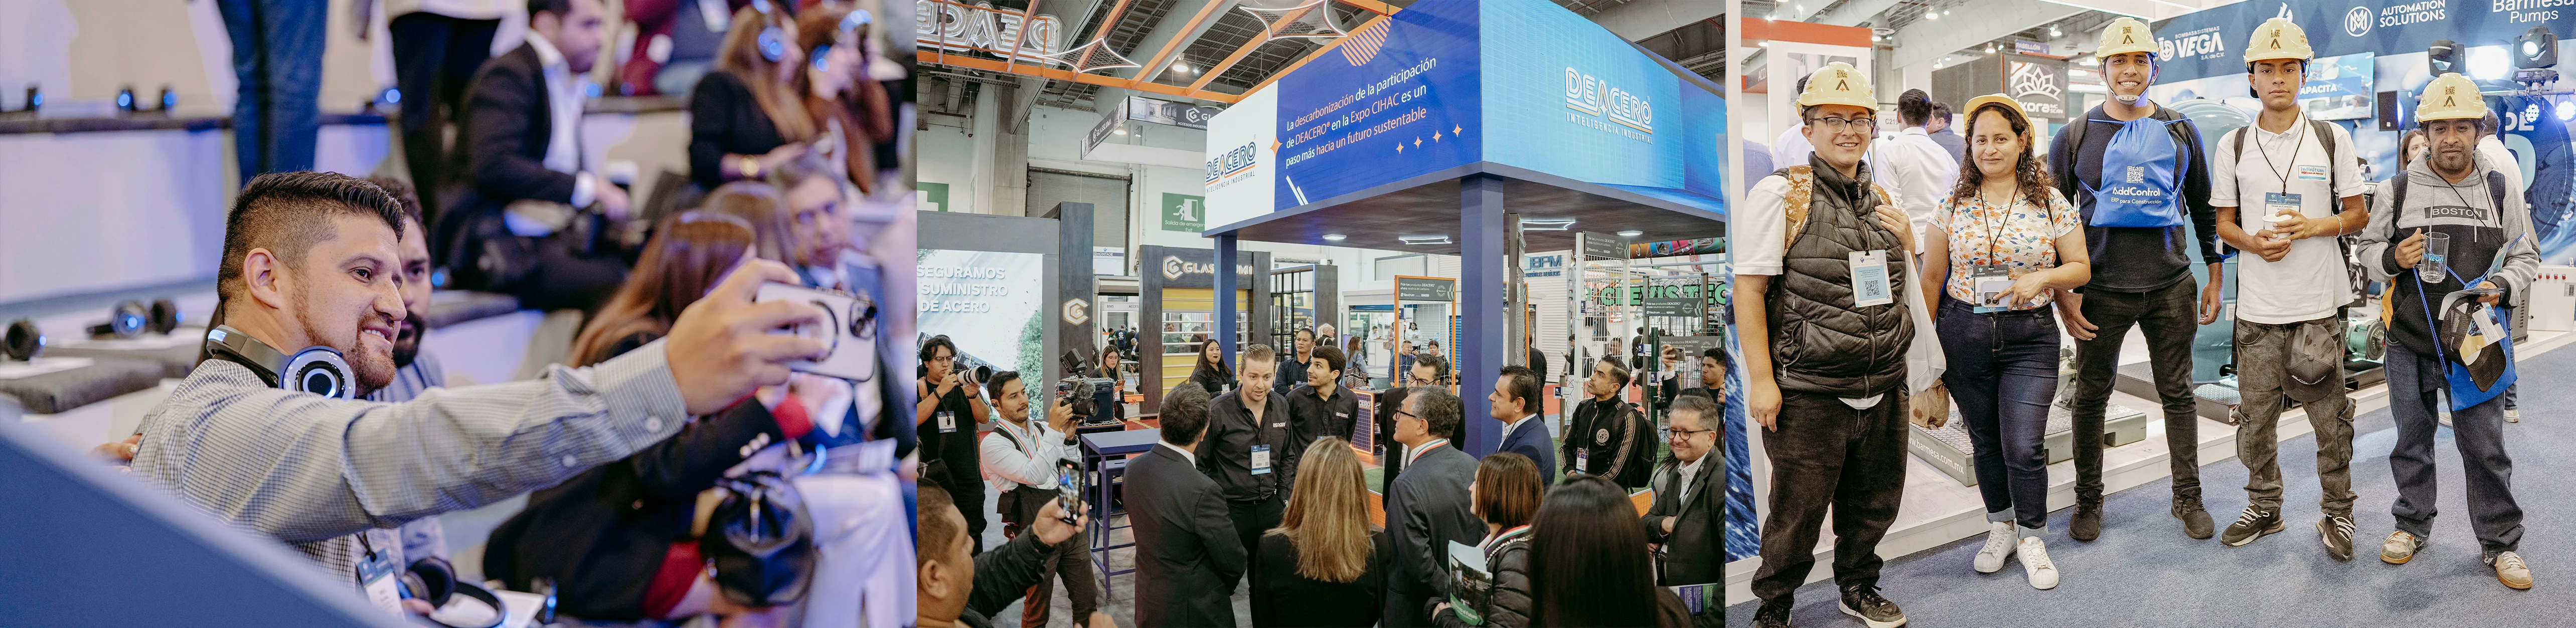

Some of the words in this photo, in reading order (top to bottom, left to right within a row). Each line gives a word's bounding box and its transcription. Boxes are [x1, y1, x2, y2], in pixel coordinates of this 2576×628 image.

[2381, 0, 2446, 17] AUTOMATION
[2379, 9, 2446, 28] SOLUTIONS
[2510, 10, 2558, 24] Pumps
[2175, 32, 2224, 58] VEGA
[1287, 121, 1294, 131] La
[1295, 94, 1354, 127] descarbonización
[1355, 88, 1366, 101] de
[1367, 84, 1375, 96] la
[1377, 57, 1436, 95] participación
[1286, 137, 1295, 149] de
[1331, 120, 1341, 131] en
[1342, 115, 1349, 126] la
[1351, 108, 1370, 123] Expo
[1372, 92, 1399, 115] CIHAC
[1401, 91, 1411, 103] es
[1414, 85, 1426, 98] un
[1566, 112, 1619, 135] INTELIGENCIA
[1621, 128, 1653, 144] INDUSTRIAL
[1286, 154, 1301, 169] paso
[1302, 147, 1315, 161] más
[1316, 140, 1335, 156] hacia
[1336, 138, 1346, 149] un
[1347, 128, 1372, 145] futuro
[1374, 106, 1426, 135] sustentable
[1206, 180, 1229, 193] NTELIGENCIA
[1231, 171, 1255, 184] INDUSTRIAL
[2112, 186, 2160, 196] AddControl
[2432, 208, 2482, 218] BOSTON
[1183, 262, 1252, 275] GLASMI
[1531, 255, 1562, 268] BPM
[921, 283, 1009, 296] SUMINISTRO
[920, 300, 939, 312] DE
[943, 300, 990, 313] ACERO
[1358, 399, 1371, 408] CERO
